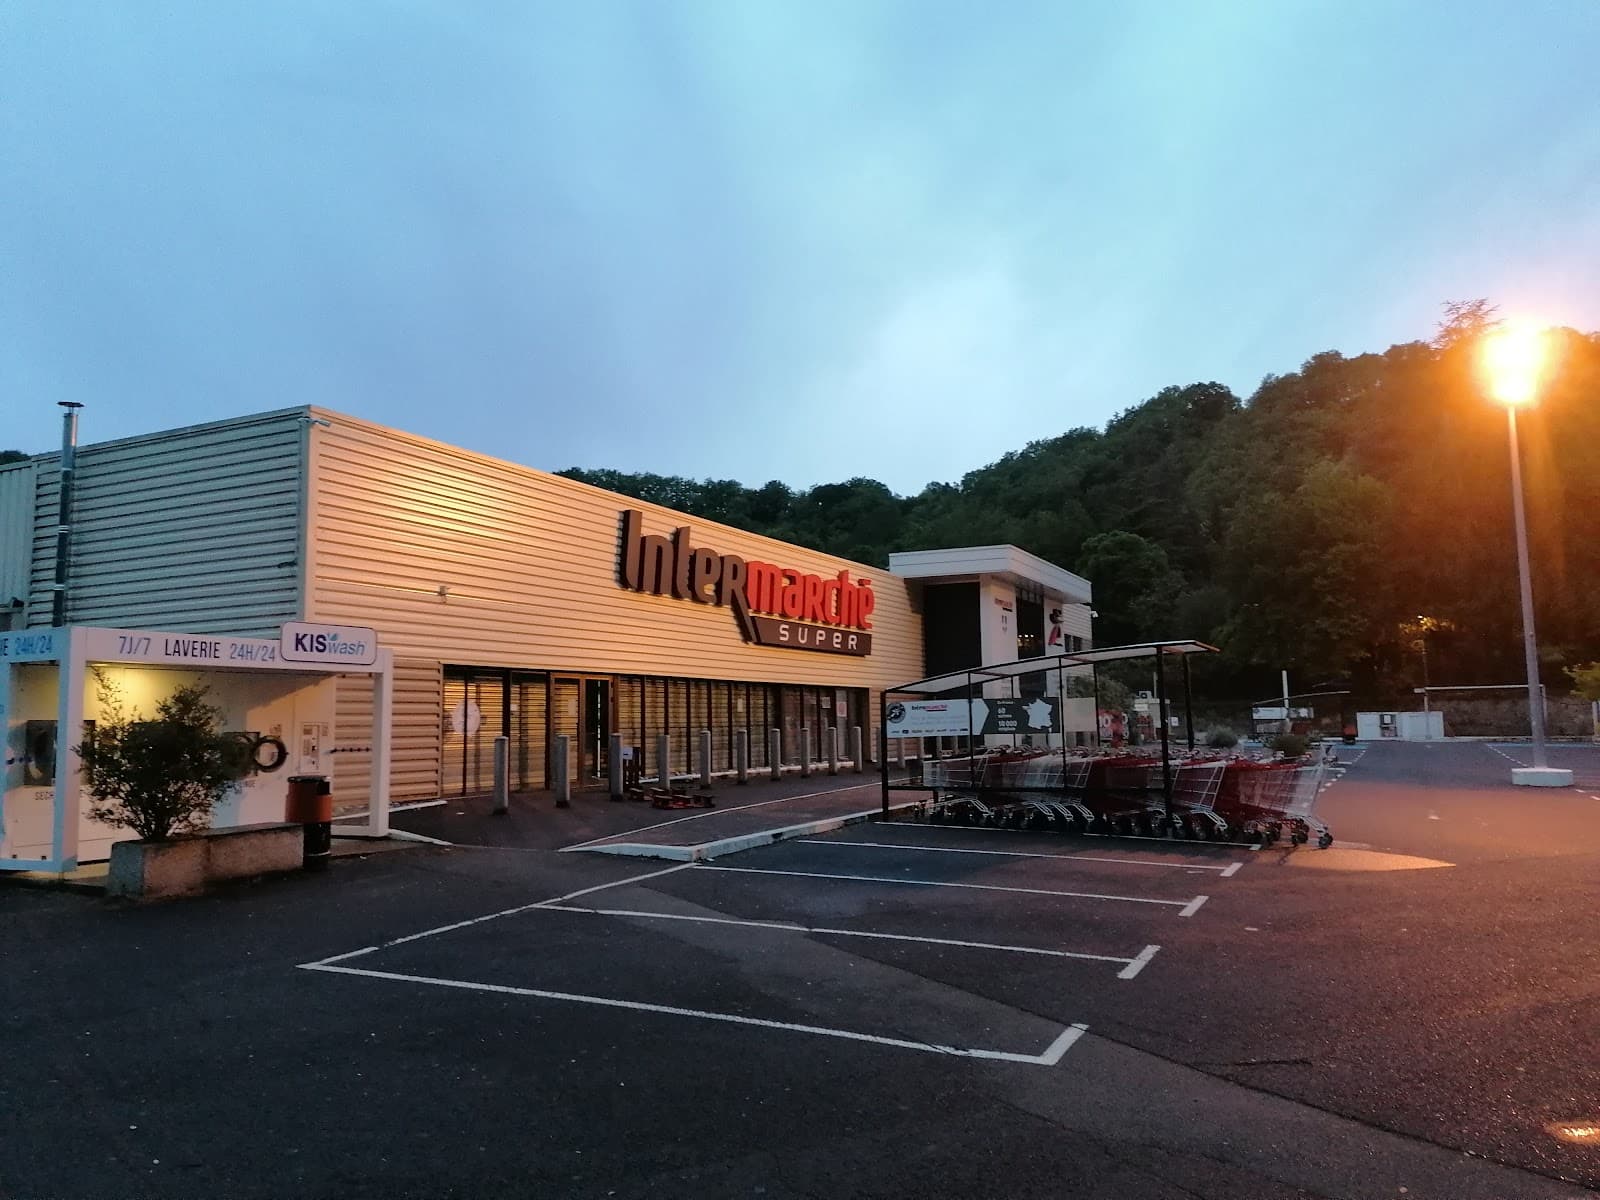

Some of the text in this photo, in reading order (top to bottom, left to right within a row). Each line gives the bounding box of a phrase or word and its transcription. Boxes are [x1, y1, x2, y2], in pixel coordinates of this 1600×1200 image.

[164, 638, 221, 659] LAVERIE
[229, 643, 276, 662] 24H/24
[779, 624, 858, 651] SUPER
